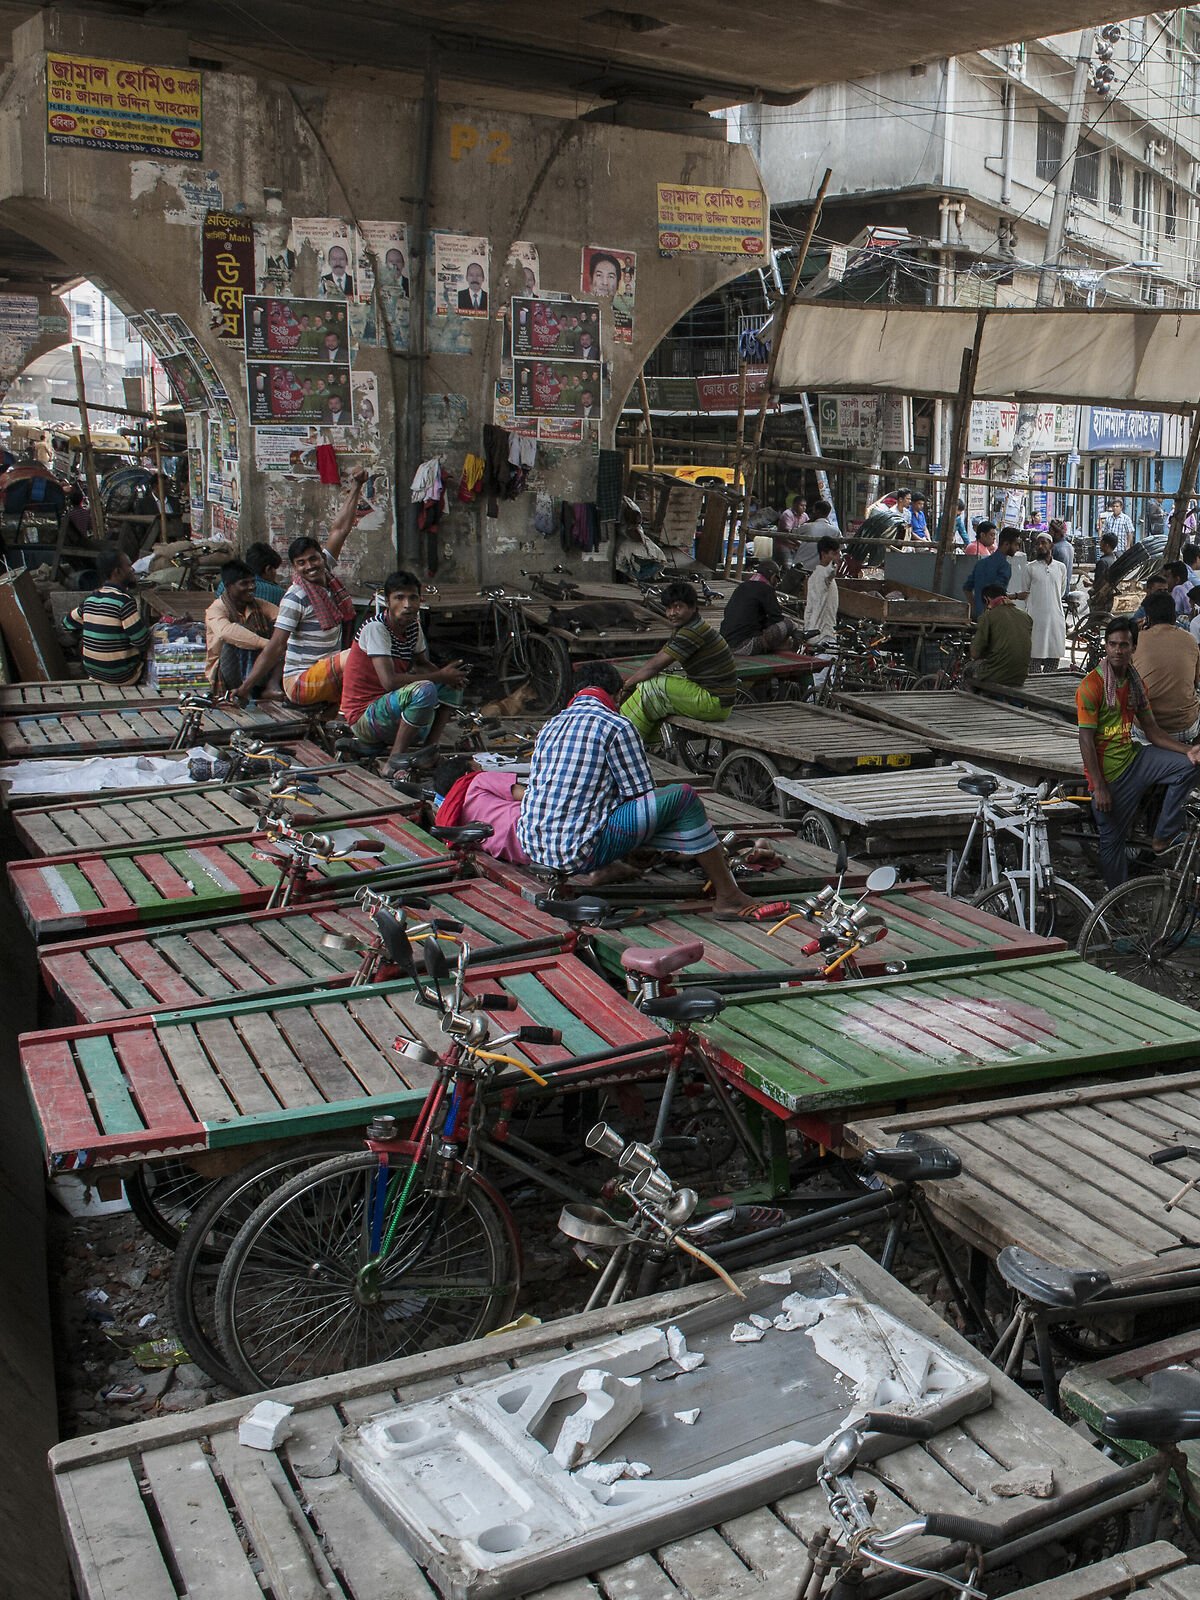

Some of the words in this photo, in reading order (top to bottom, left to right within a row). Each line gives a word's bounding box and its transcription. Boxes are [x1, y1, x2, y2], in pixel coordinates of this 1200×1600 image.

[50, 60, 110, 87] জামাল
[116, 67, 175, 94] হোমিও
[50, 86, 72, 101] ডাঃ
[75, 89, 113, 107] জামাল
[117, 91, 150, 113] উদ্দিন
[154, 99, 199, 118] আহমেদ
[659, 189, 700, 206] জামাল
[705, 189, 744, 209] হোমিও
[677, 212, 703, 223] জামাল
[229, 234, 251, 243] Math
[1150, 415, 1161, 443] হল
